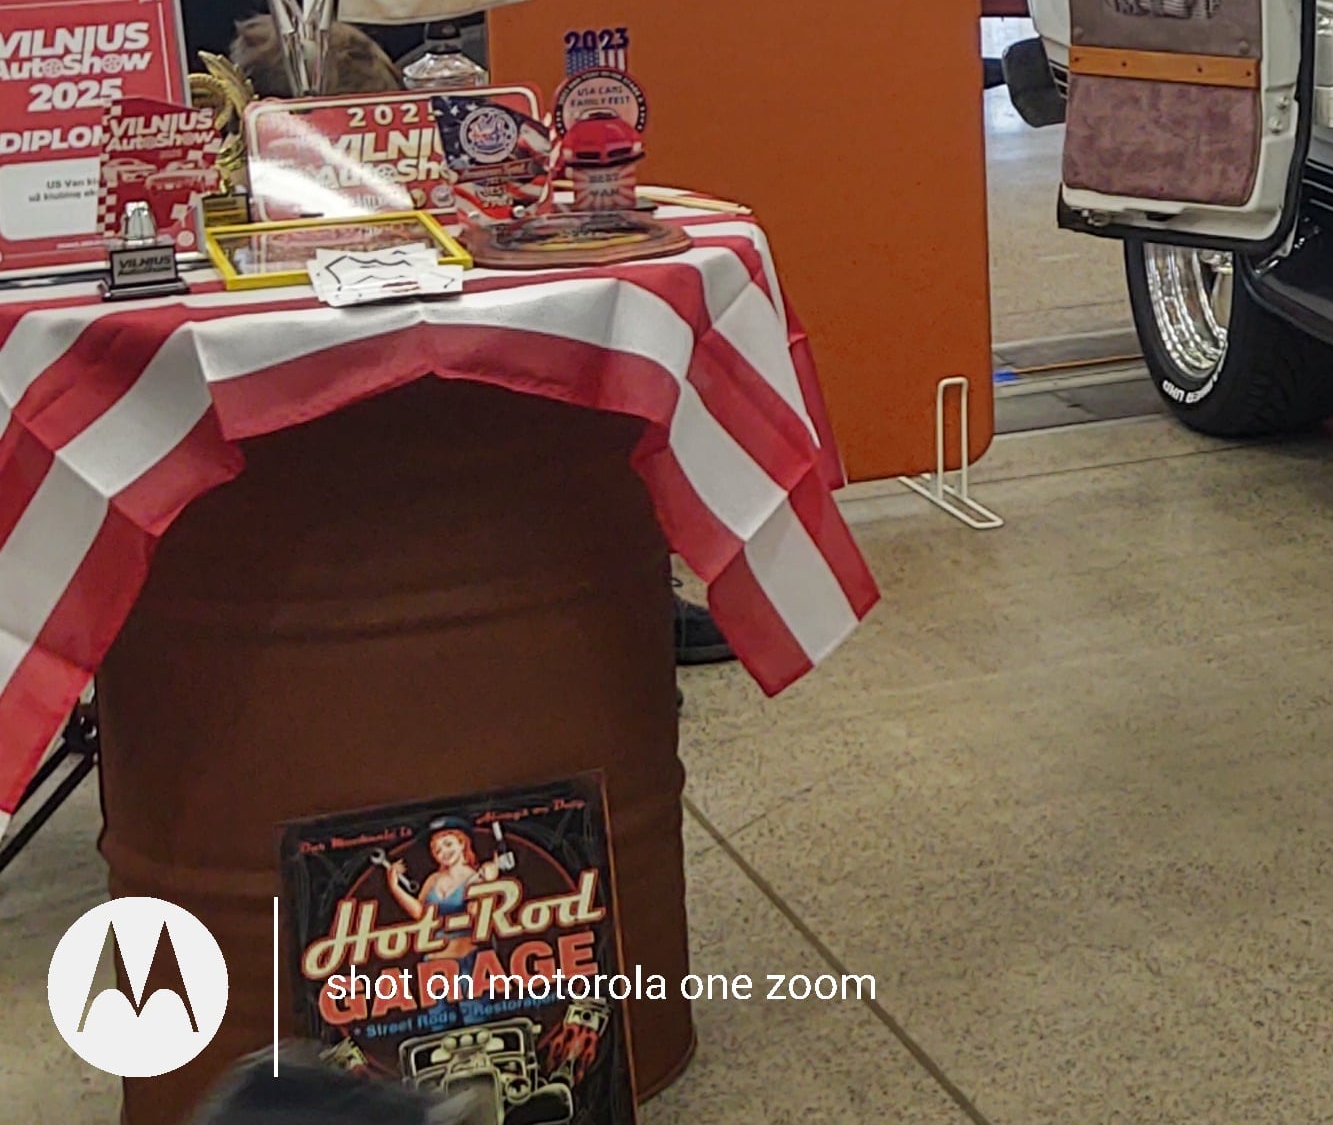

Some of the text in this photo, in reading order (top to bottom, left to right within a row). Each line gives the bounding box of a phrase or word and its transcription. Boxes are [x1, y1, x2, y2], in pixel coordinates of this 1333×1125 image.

[0, 22, 150, 60] VILNIUS
[565, 28, 629, 51] 2023
[28, 78, 123, 113] 2025
[109, 108, 214, 137] VILNIUS
[0, 125, 103, 156] DIPLO
[47, 180, 61, 189] US
[119, 255, 172, 269] VILNIUS
[302, 867, 606, 980] Hot-Rod
[318, 930, 600, 1025] GARAGE
[366, 1018, 413, 1038] Street
[417, 1010, 457, 1029] Rods
